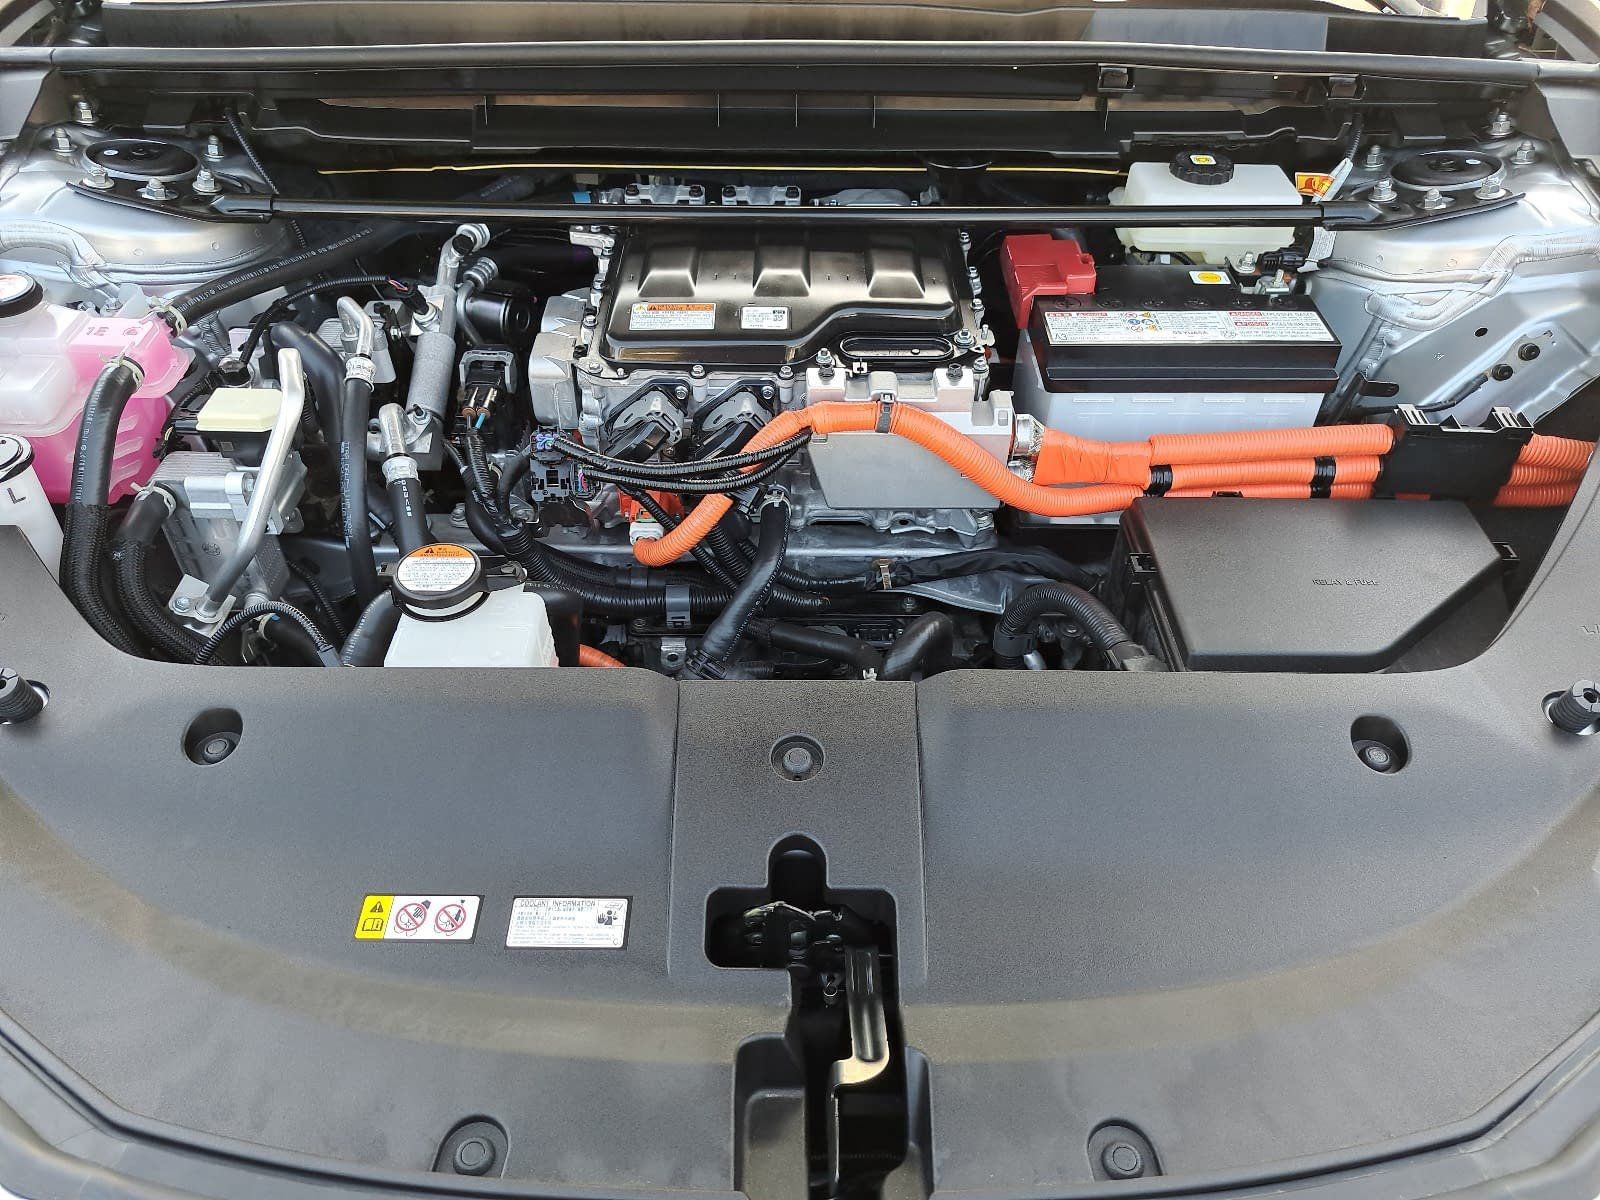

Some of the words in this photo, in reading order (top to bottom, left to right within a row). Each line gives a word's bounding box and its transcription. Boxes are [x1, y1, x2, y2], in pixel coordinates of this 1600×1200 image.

[7, 487, 26, 504] L
[1312, 578, 1342, 586] RELAY
[1354, 578, 1380, 586] FUSE
[520, 899, 549, 908] COOLANT
[552, 899, 596, 907] INFORMATION
